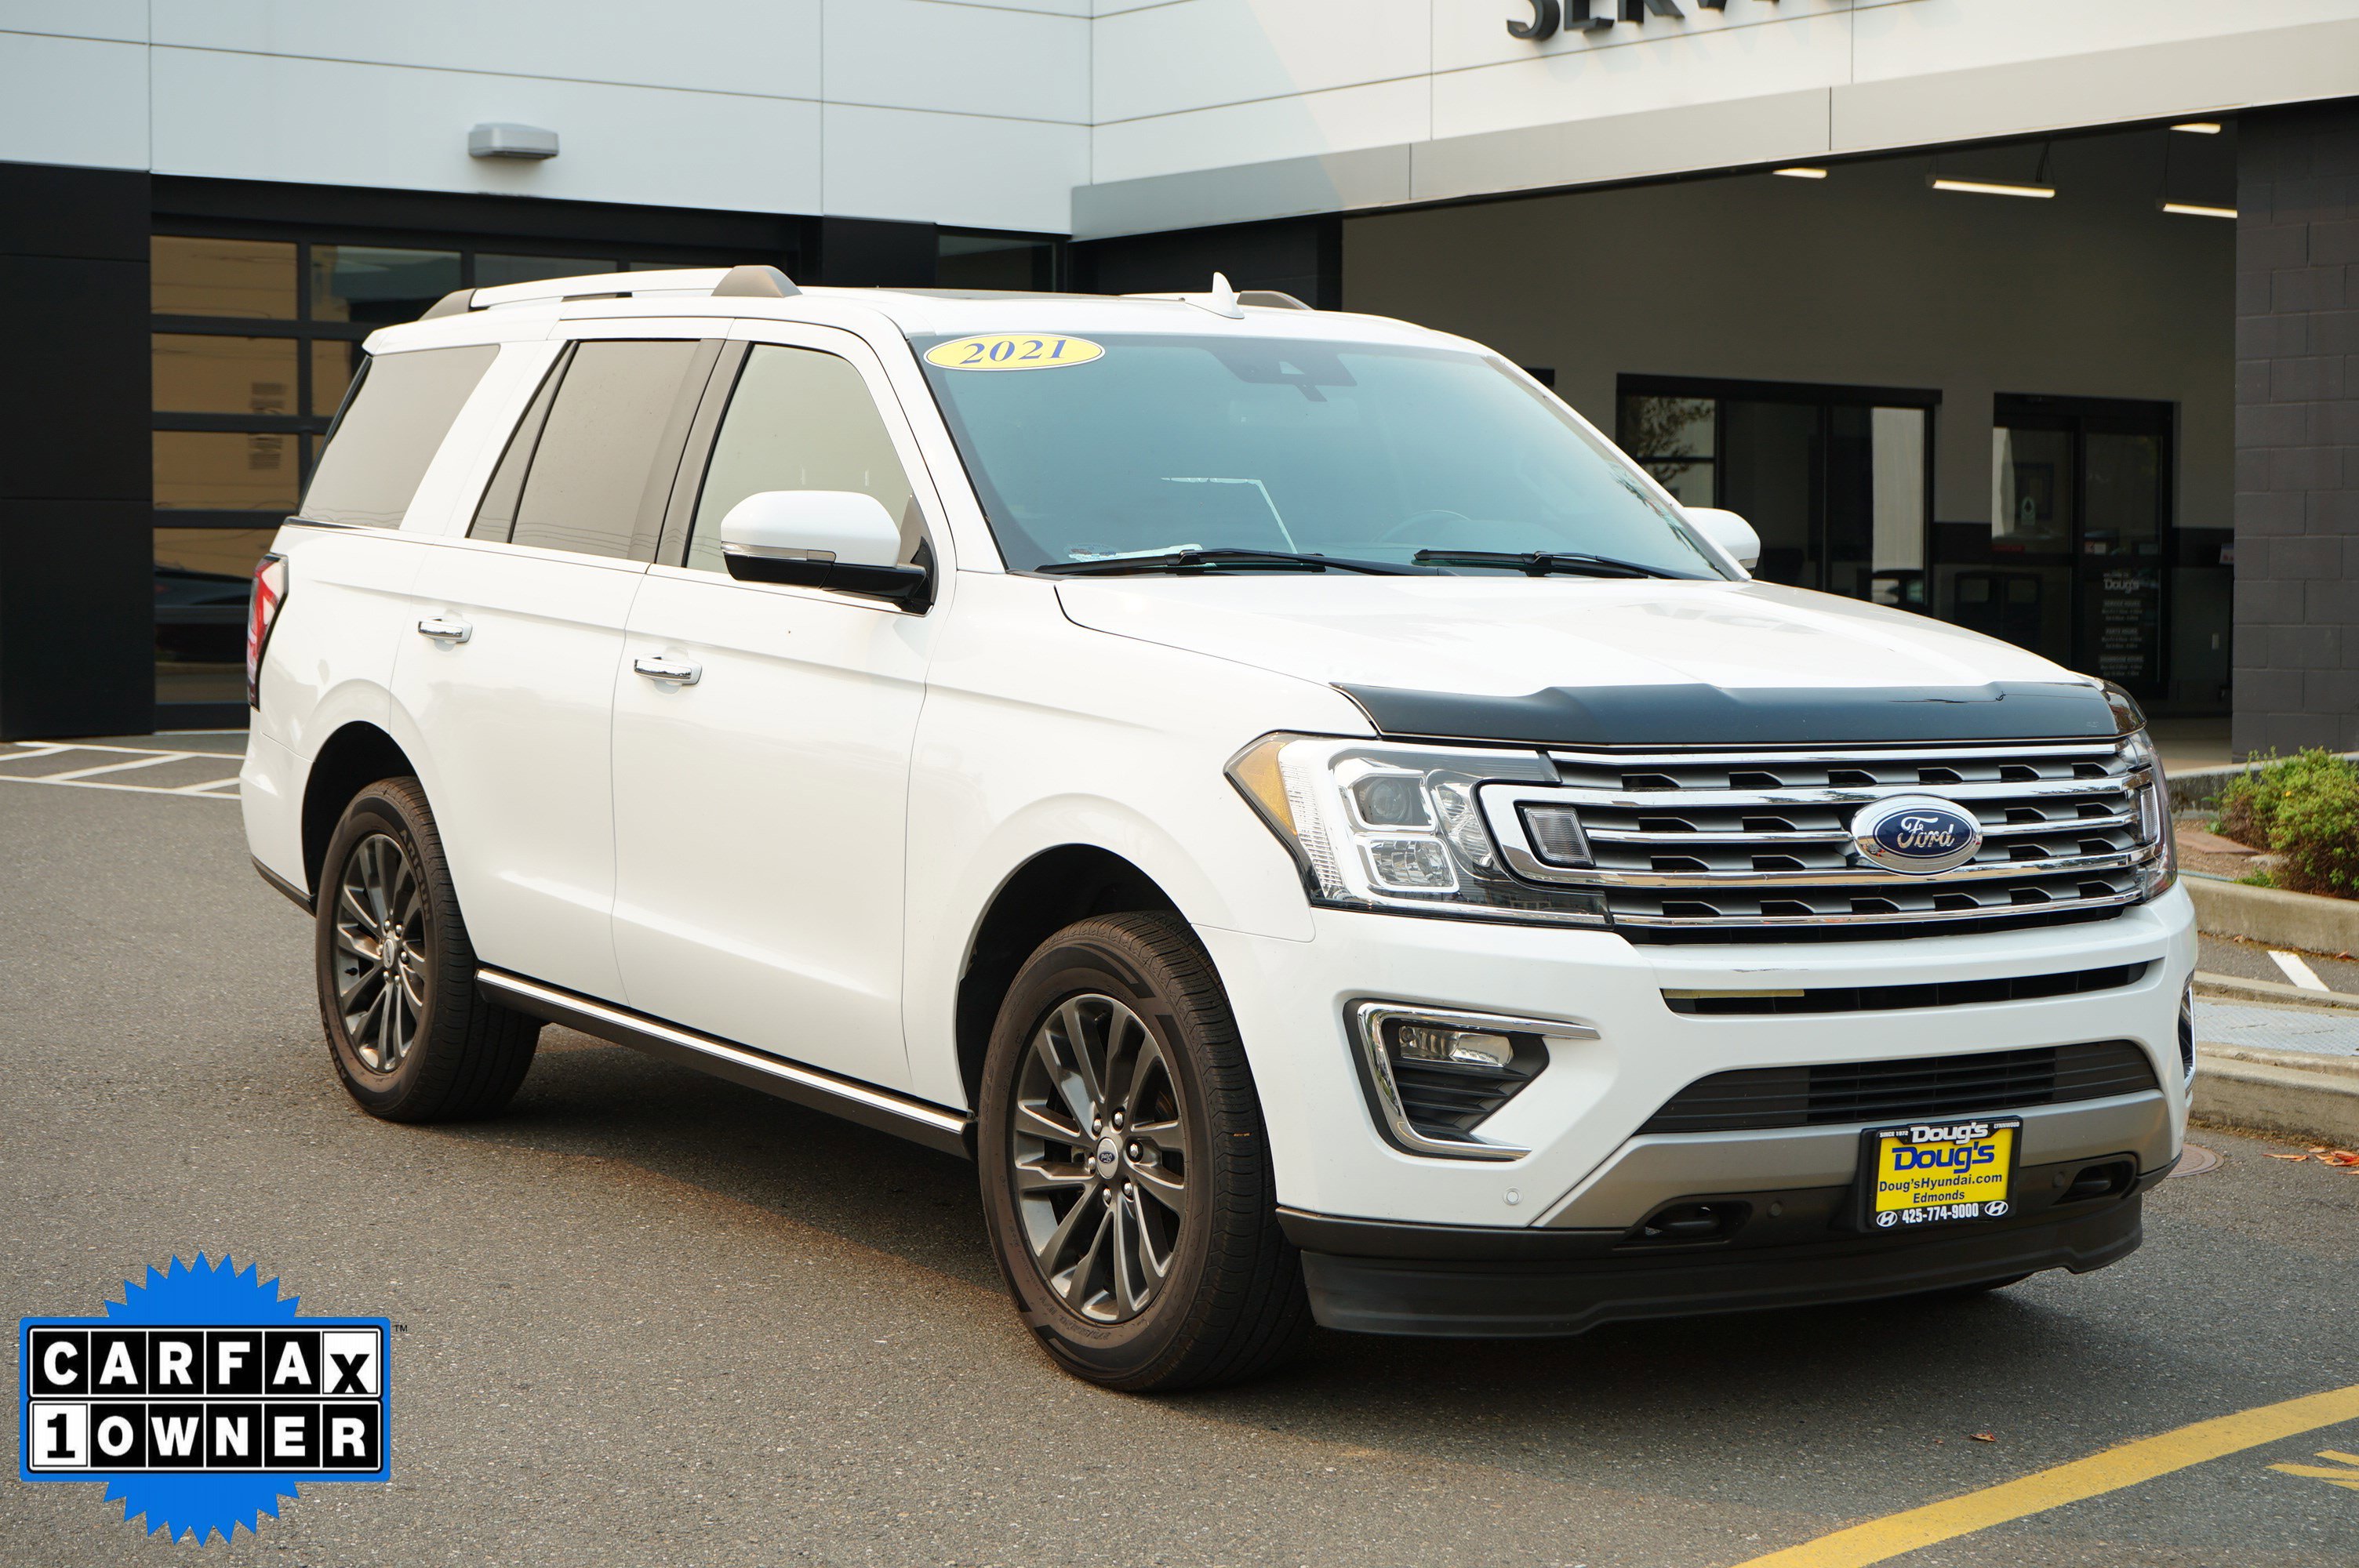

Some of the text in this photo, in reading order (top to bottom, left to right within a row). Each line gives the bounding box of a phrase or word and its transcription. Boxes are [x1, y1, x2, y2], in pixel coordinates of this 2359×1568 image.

[958, 339, 1067, 365] 2021
[1897, 816, 1955, 849] Ford
[1910, 1122, 1988, 1145] Doug's
[1892, 1142, 1995, 1174] Doug's
[1879, 1174, 2002, 1192] Doug'sHyundai.com
[1913, 1190, 1965, 1203] Edmonds
[1902, 1203, 1979, 1224] 425-774-9000
